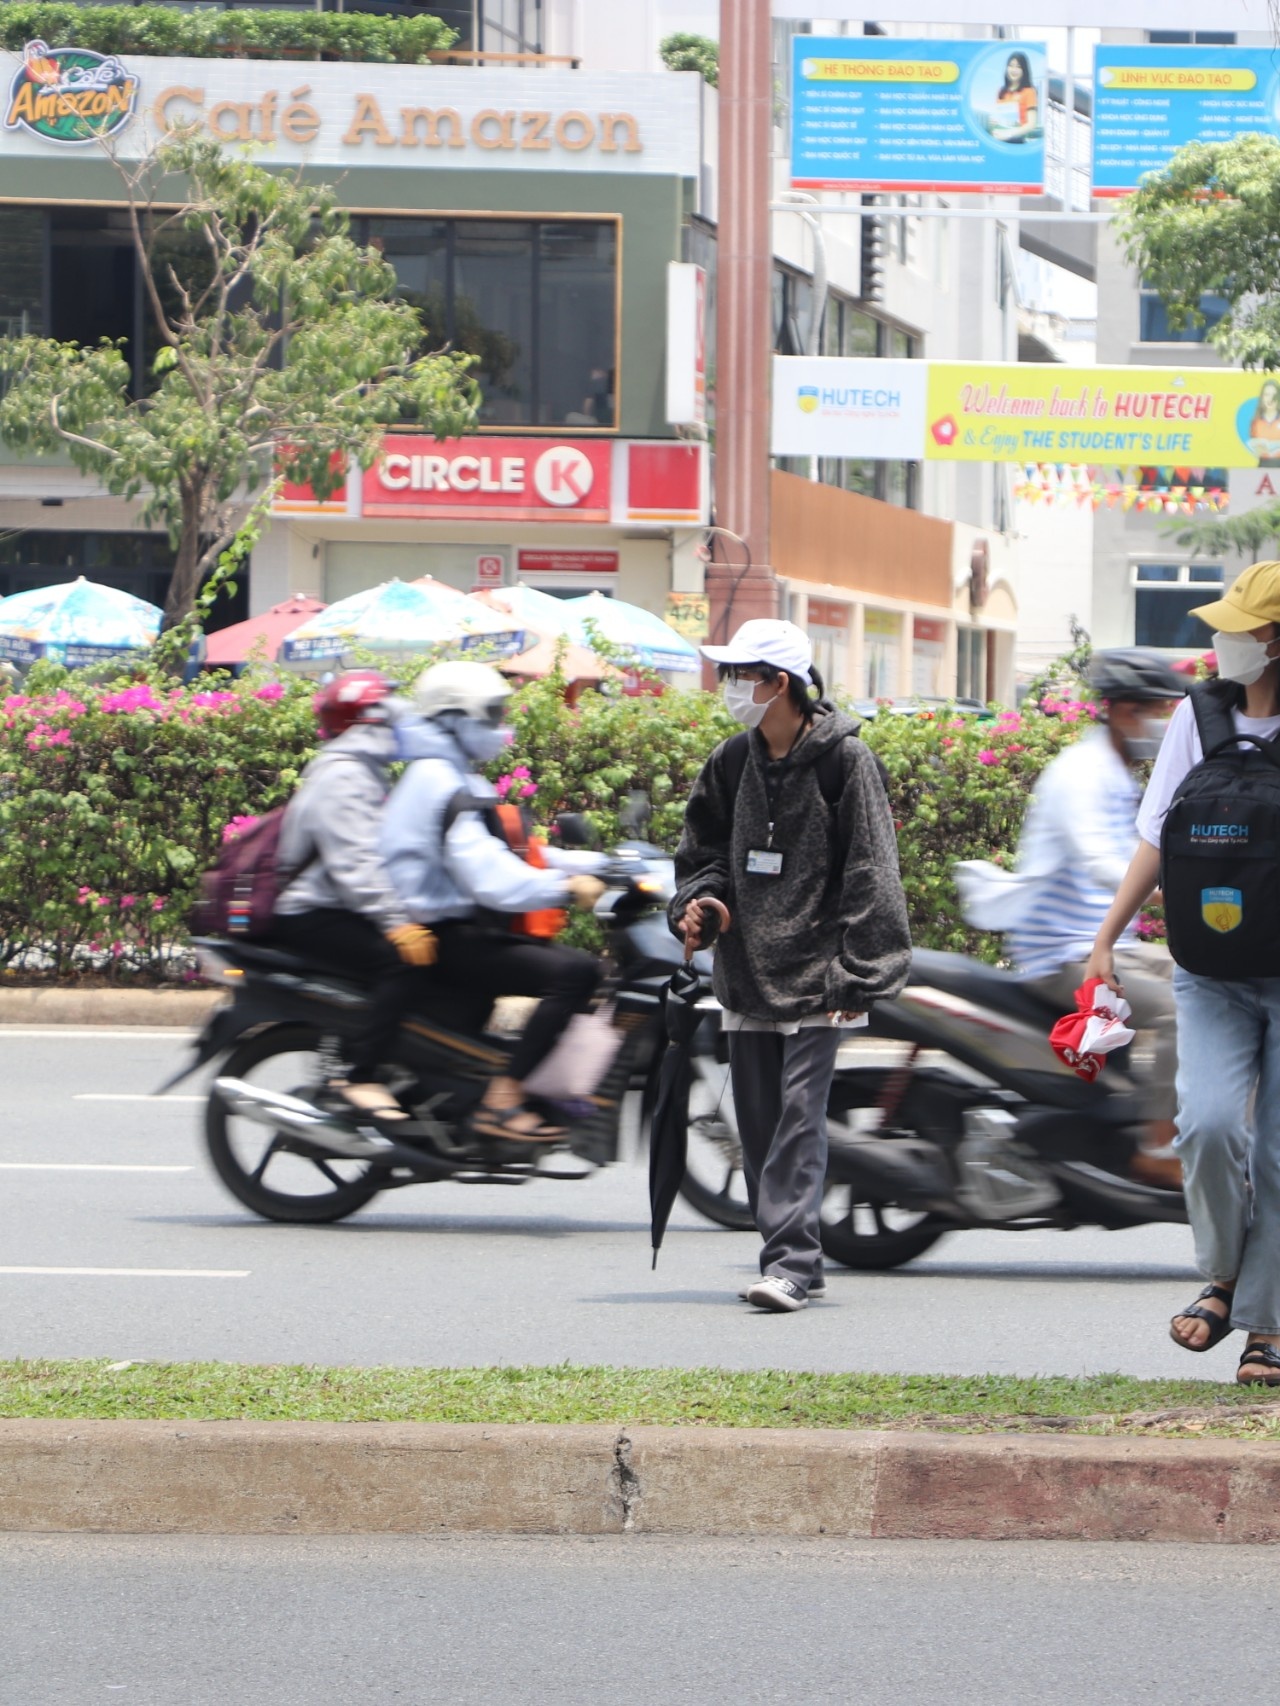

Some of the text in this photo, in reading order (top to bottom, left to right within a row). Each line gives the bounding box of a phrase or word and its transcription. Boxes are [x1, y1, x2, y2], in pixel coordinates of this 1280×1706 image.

[152, 84, 643, 153] Café Amazon
[822, 387, 901, 408] HUTECH
[962, 383, 1211, 419] Welcome back to HUTECH
[979, 424, 1019, 454] Enjoy
[1023, 429, 1056, 449] THE
[1058, 430, 1153, 451] STUDENT'S
[1155, 433, 1193, 452] LIFE
[378, 453, 525, 493] CIRCLE
[1254, 472, 1277, 496] A
[1191, 824, 1249, 836] HUTECH
